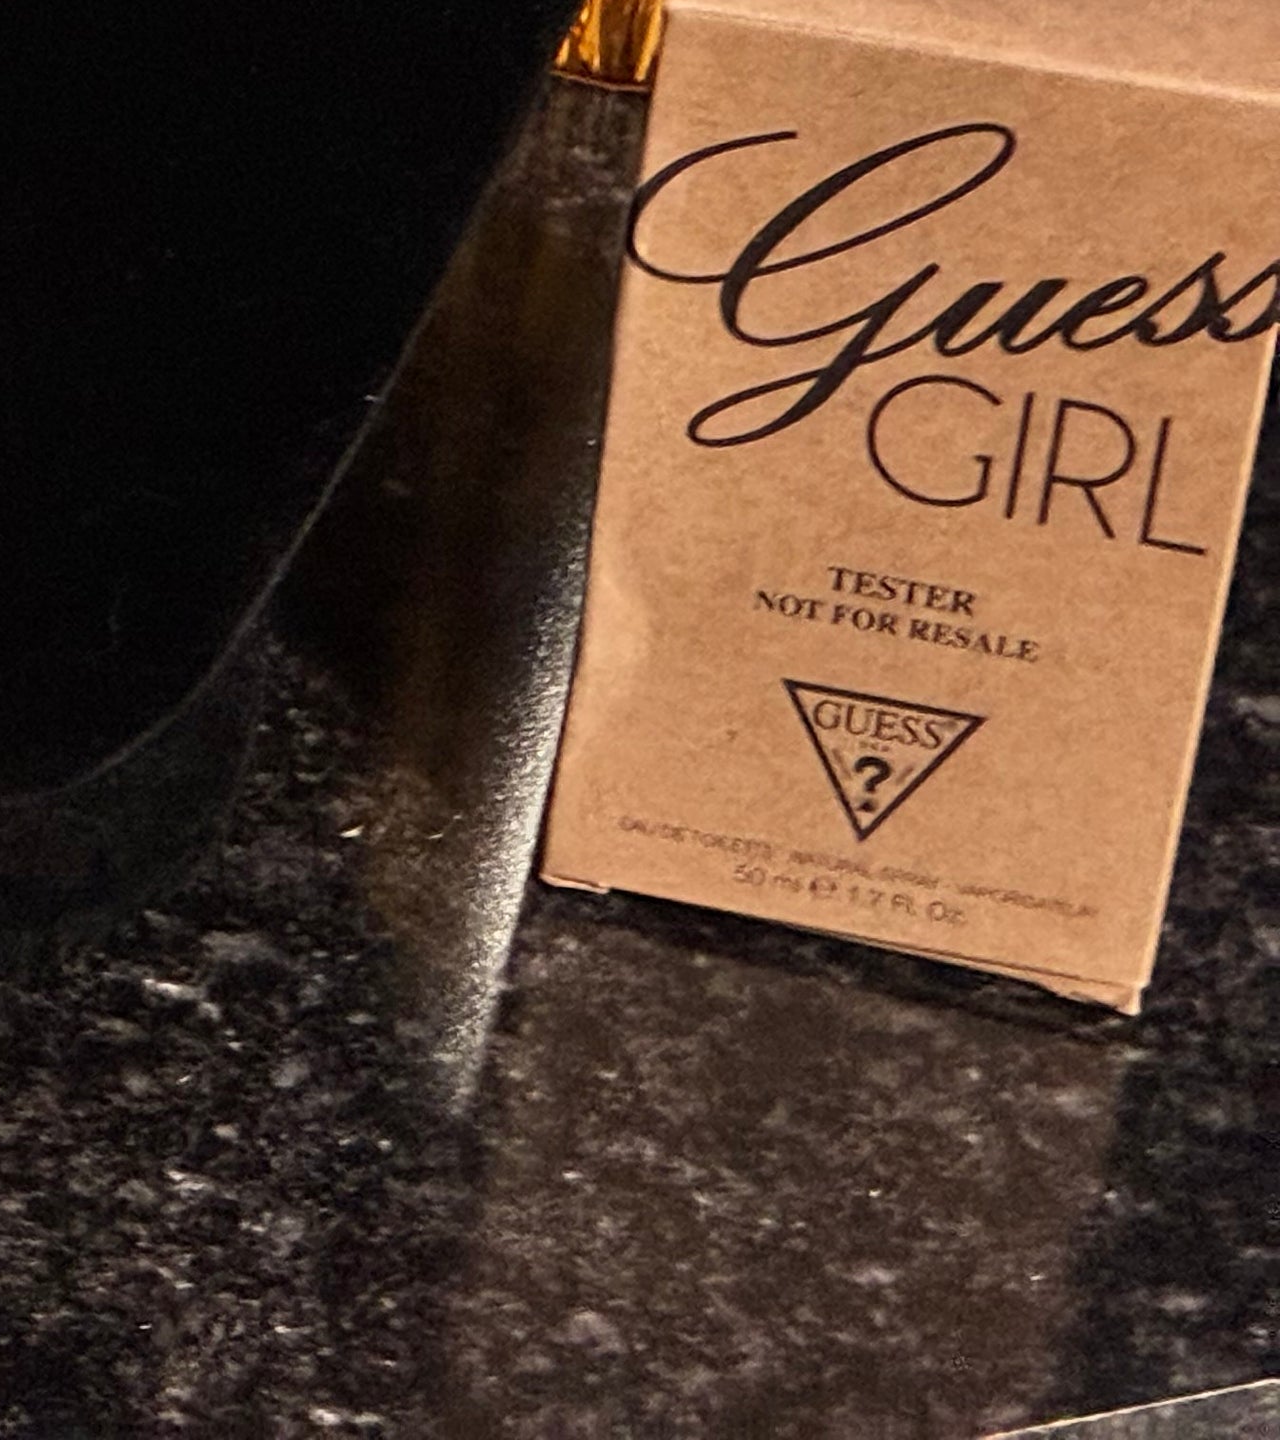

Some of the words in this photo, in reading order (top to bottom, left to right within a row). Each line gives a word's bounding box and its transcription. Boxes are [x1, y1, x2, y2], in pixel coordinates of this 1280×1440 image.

[626, 122, 1280, 447] Guess
[866, 373, 1208, 558] GIRL
[753, 589, 824, 621] NOT
[829, 603, 899, 637] FOR
[908, 617, 1040, 664] RESALE
[827, 565, 977, 617] TESTER
[813, 698, 943, 750] GUESS
